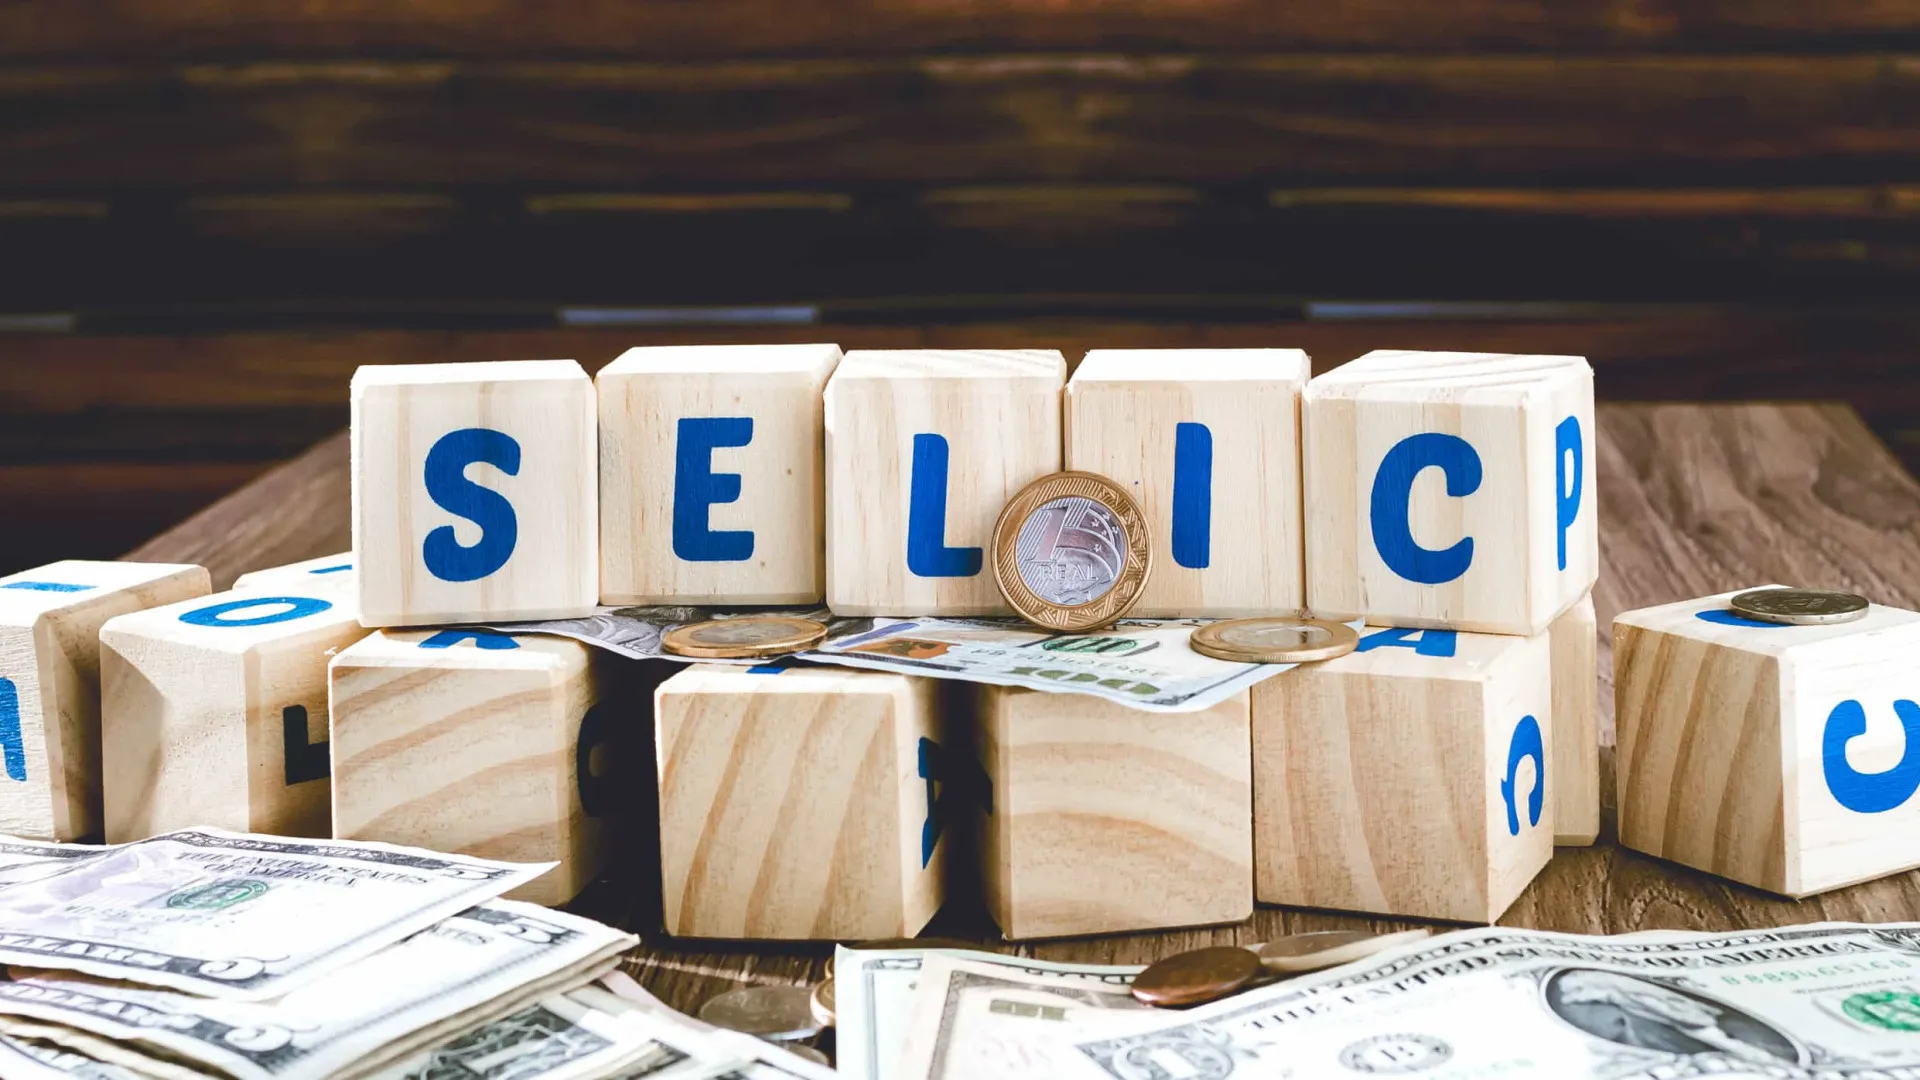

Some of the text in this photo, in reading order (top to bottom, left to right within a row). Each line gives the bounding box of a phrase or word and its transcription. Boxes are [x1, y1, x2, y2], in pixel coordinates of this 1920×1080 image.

[1555, 415, 1583, 572] P
[1038, 563, 1099, 581] REAL
[178, 597, 333, 627] O
[1701, 940, 1870, 966] AMERICA
